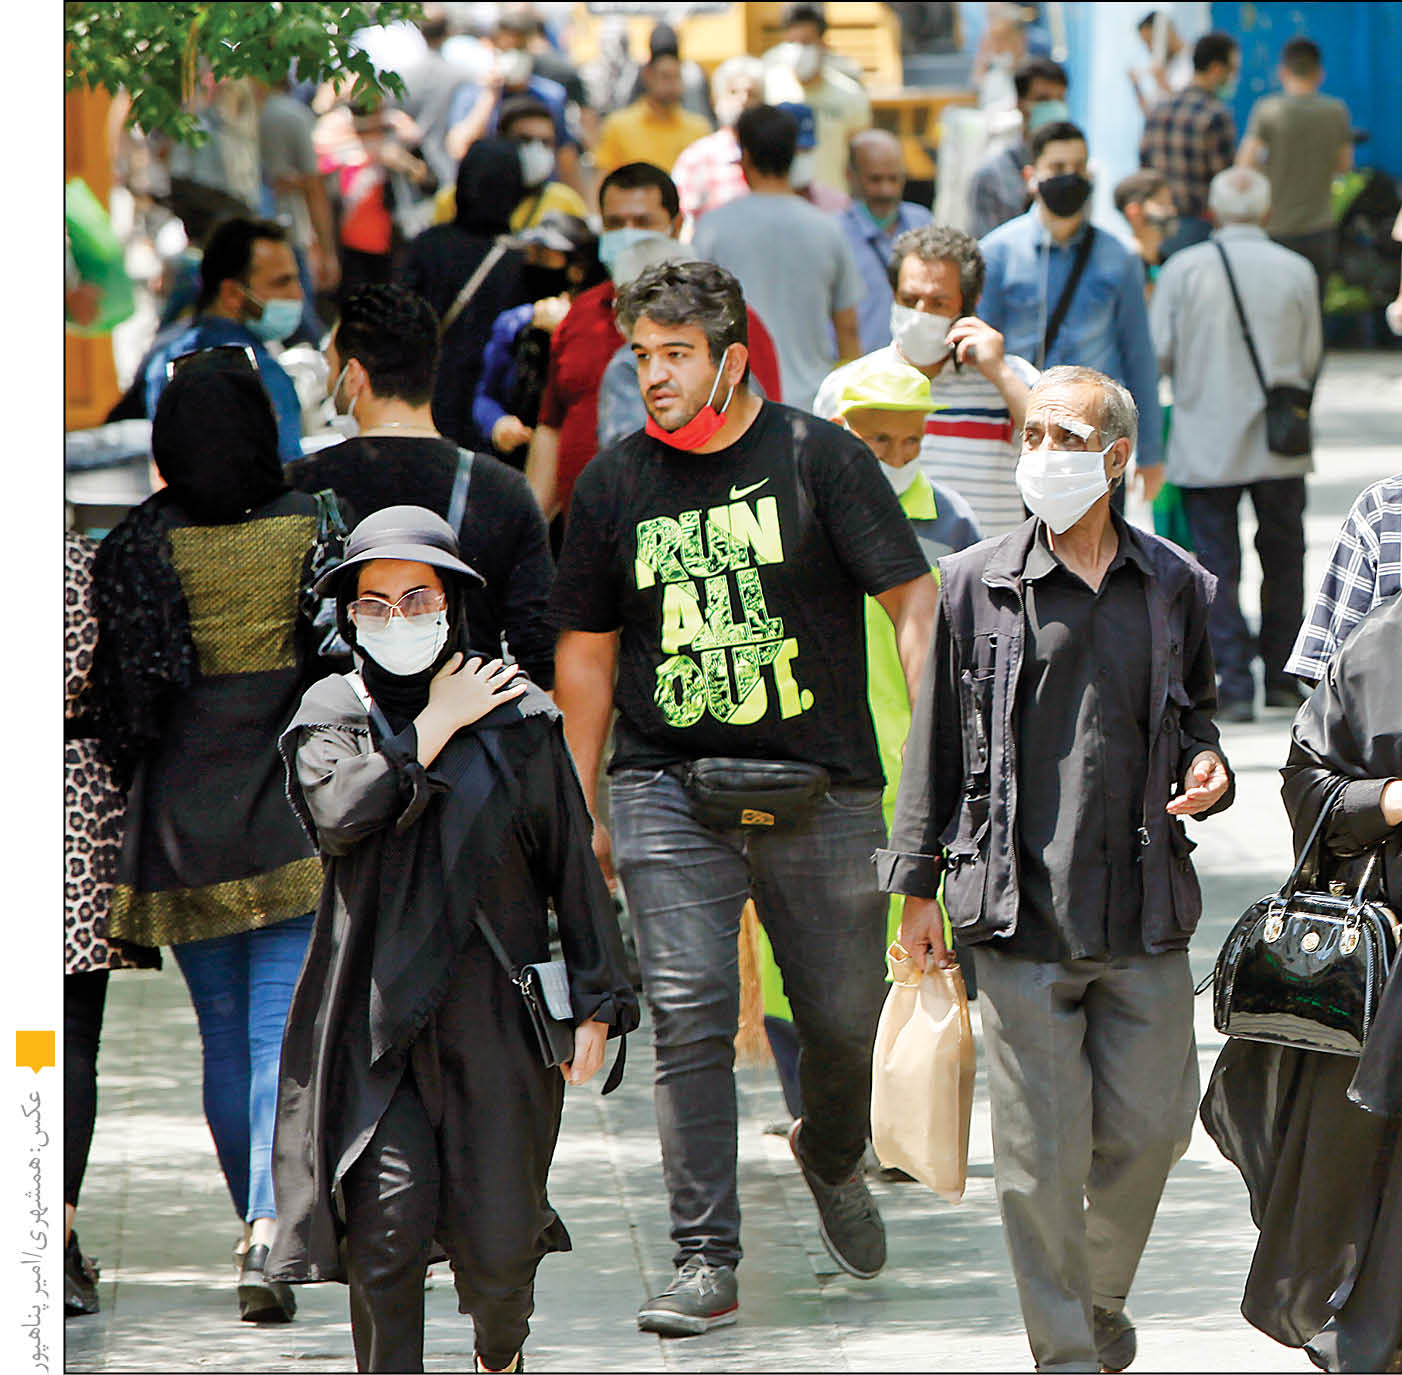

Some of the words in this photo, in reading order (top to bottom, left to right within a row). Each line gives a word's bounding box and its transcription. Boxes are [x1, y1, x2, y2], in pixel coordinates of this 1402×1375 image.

[634, 496, 785, 590] RUN
[661, 567, 784, 655] ALL
[653, 637, 815, 728] OUT.
